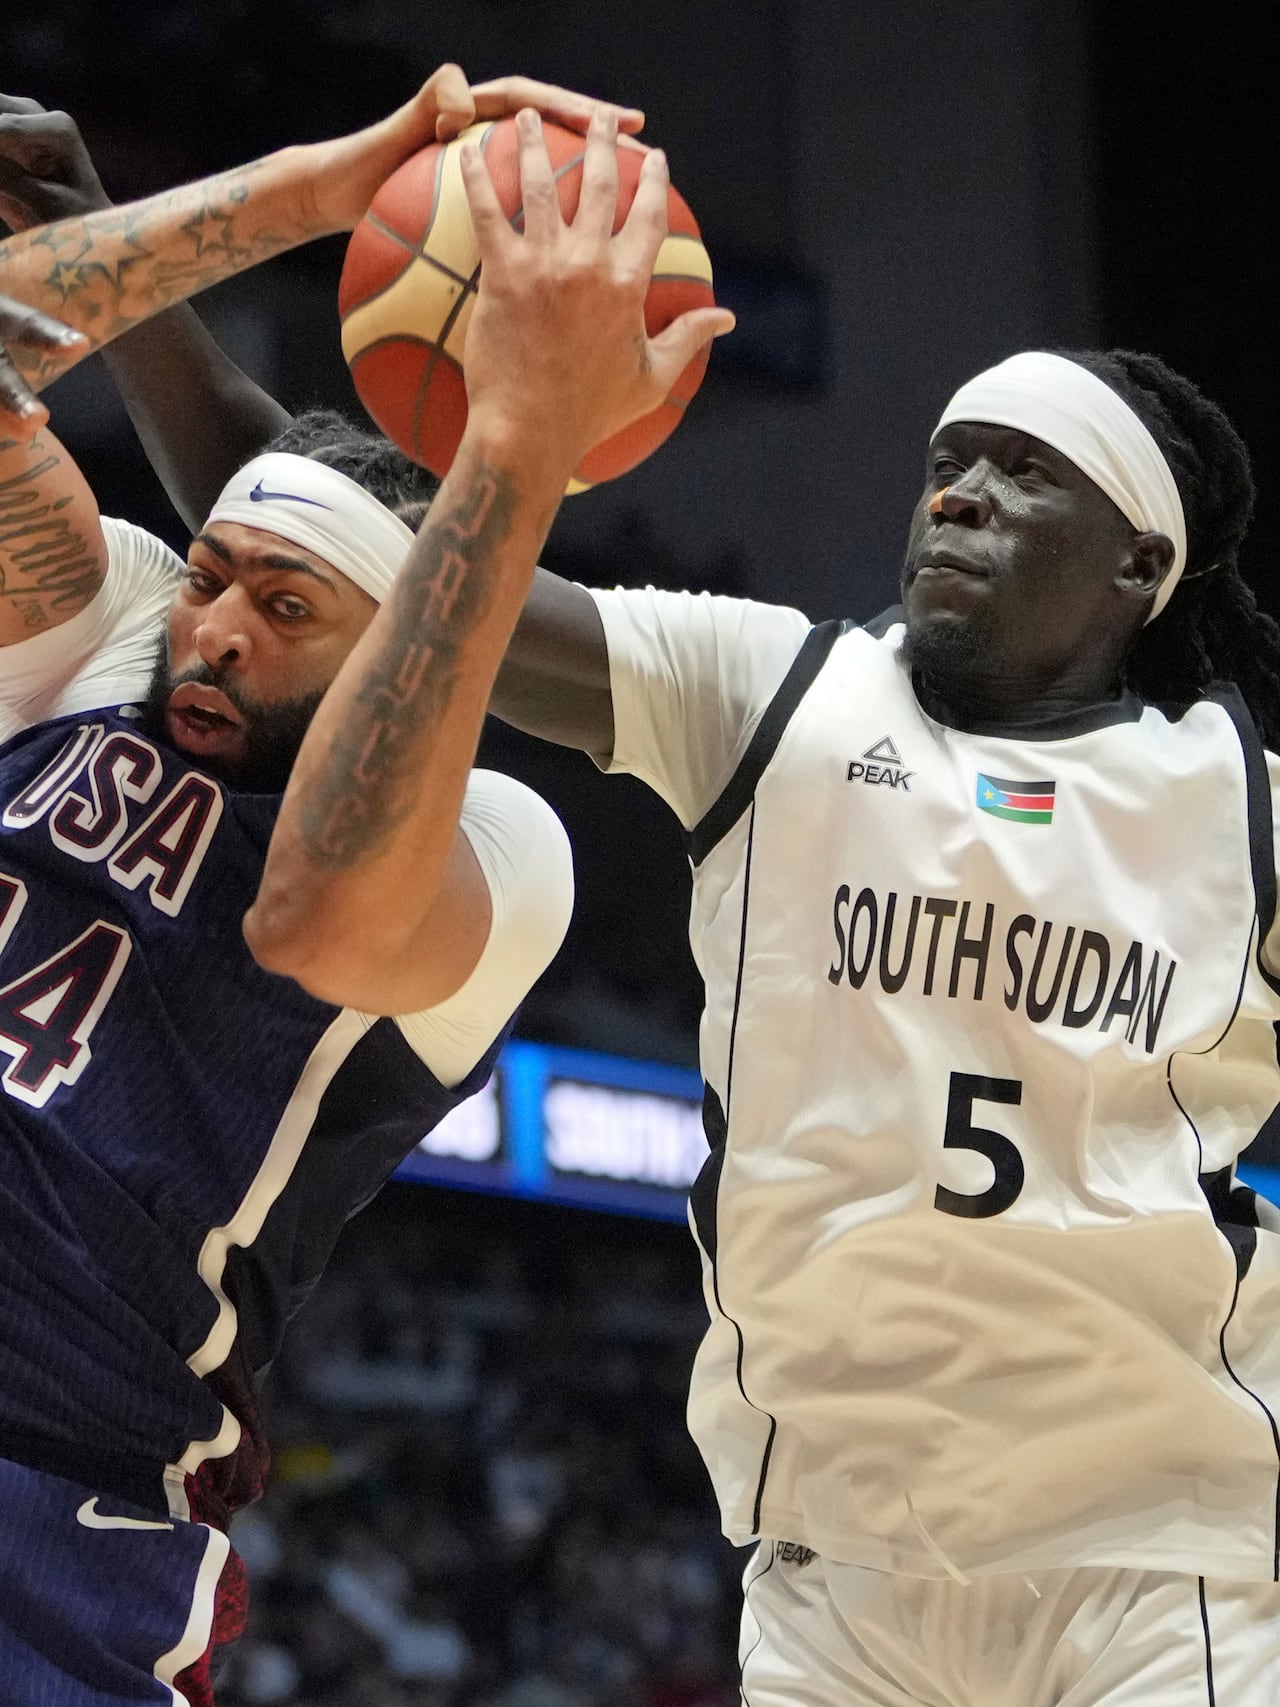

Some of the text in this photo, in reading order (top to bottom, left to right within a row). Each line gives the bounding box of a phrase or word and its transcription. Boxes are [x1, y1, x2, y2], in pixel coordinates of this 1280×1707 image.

[2, 724, 224, 918] USA
[846, 760, 916, 792] PEAK
[827, 884, 1177, 1054] SOUTH SUDAN
[933, 1071, 1025, 1219] 5
